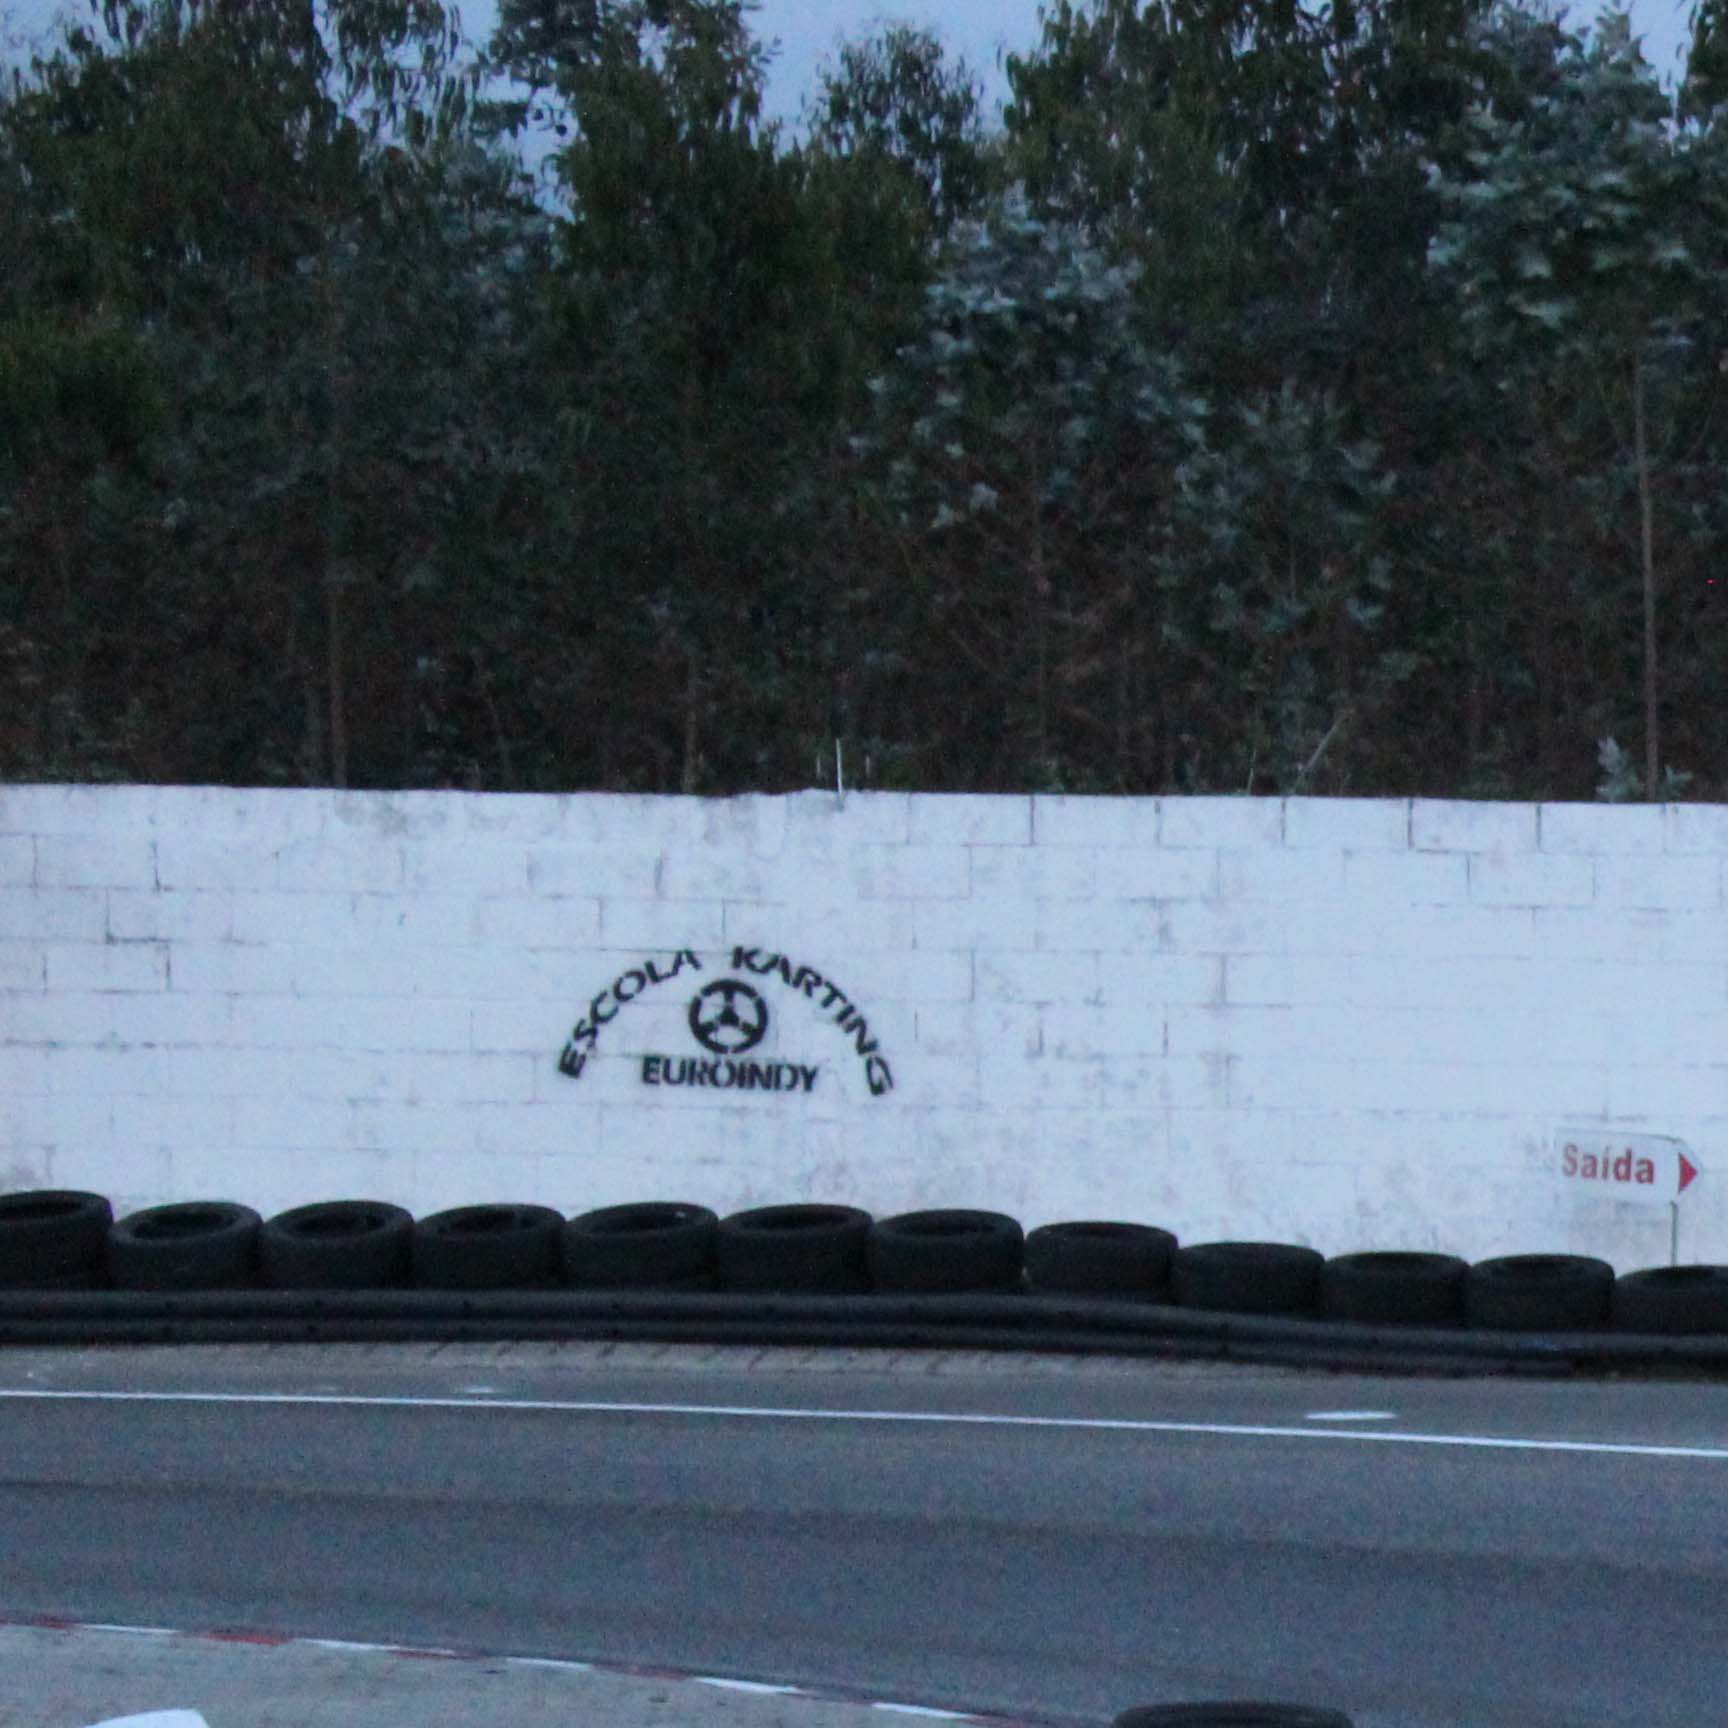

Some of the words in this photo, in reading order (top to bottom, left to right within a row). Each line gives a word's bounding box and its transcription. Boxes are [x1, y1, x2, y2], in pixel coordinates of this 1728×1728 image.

[558, 948, 703, 1080] ESCOLA
[731, 945, 894, 1096] KARTING
[641, 1055, 820, 1092] EUROINDY
[1561, 1144, 1655, 1184] Saída
